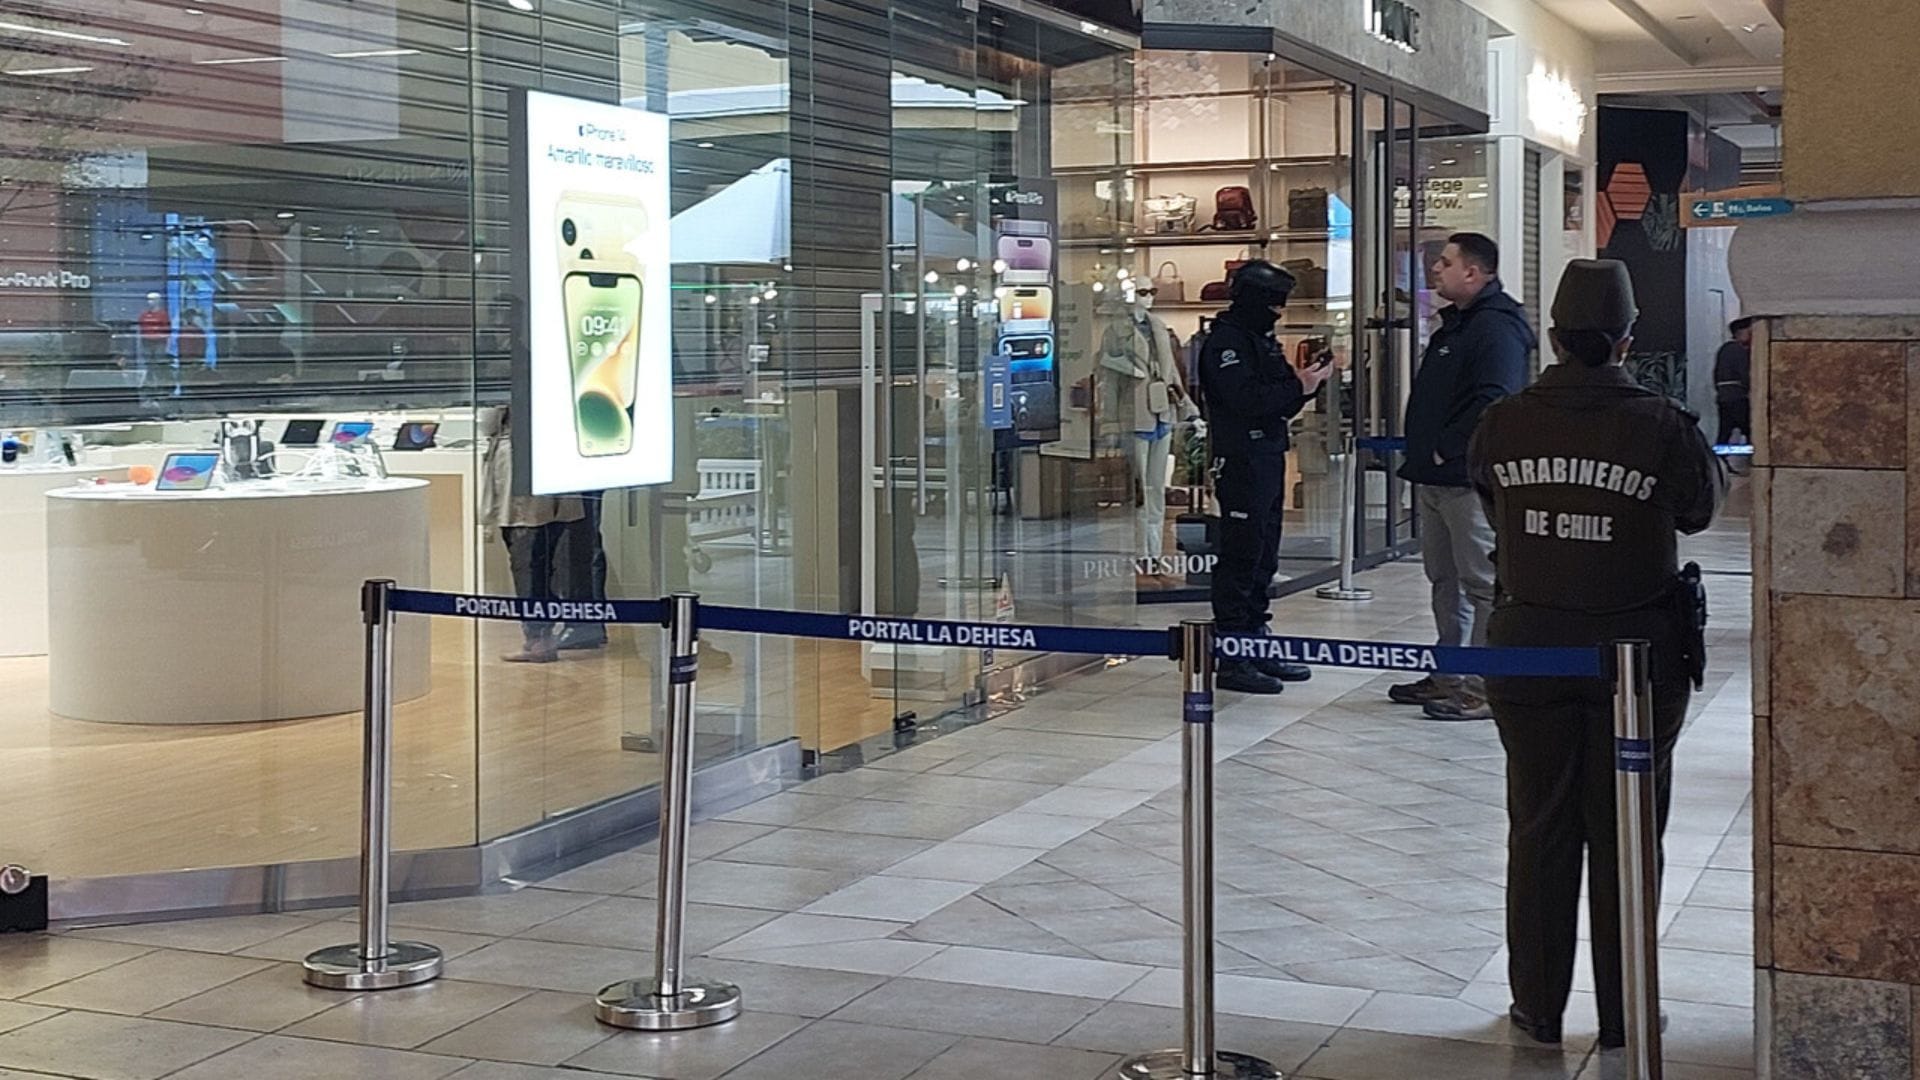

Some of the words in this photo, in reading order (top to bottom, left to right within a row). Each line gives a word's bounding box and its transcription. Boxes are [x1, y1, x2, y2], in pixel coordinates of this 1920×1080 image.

[60, 271, 91, 289] Pro
[1493, 457, 1658, 500] CARABINEROS
[1525, 509, 1549, 536] DE
[1556, 513, 1613, 541] CHILE
[455, 597, 520, 617] PORTAL
[523, 601, 545, 618] LA
[548, 602, 617, 620] DEHESA
[849, 619, 923, 641] PORTAL
[927, 624, 952, 643] LA
[956, 626, 1036, 647] DEHESA
[1303, 641, 1334, 663] LA
[1339, 644, 1438, 669] DEHESA
